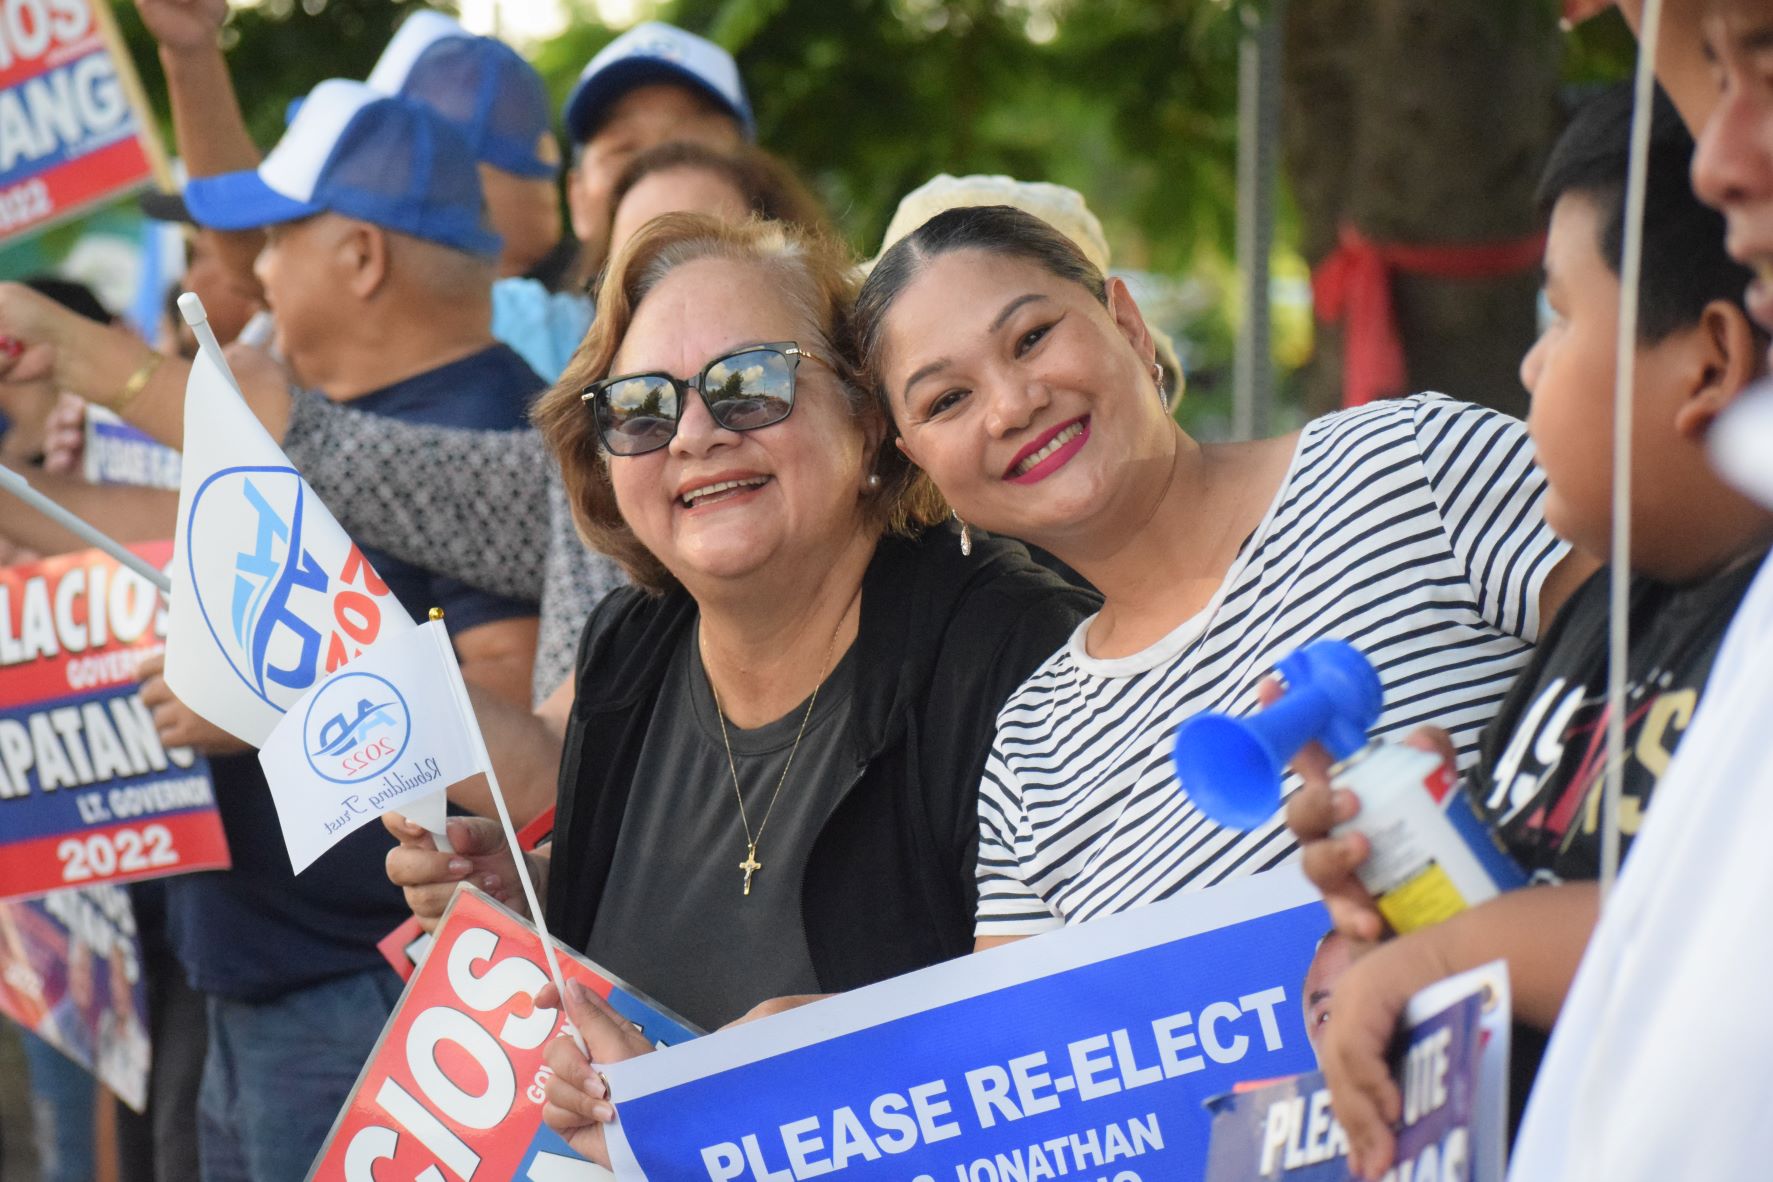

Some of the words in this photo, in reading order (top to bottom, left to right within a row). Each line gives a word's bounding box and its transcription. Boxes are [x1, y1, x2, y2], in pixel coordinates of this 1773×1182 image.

[0, 693, 195, 799] PATAN
[57, 824, 180, 882] 2022
[701, 1080, 962, 1182] PLEASE
[965, 986, 1288, 1129] RE-ELECT
